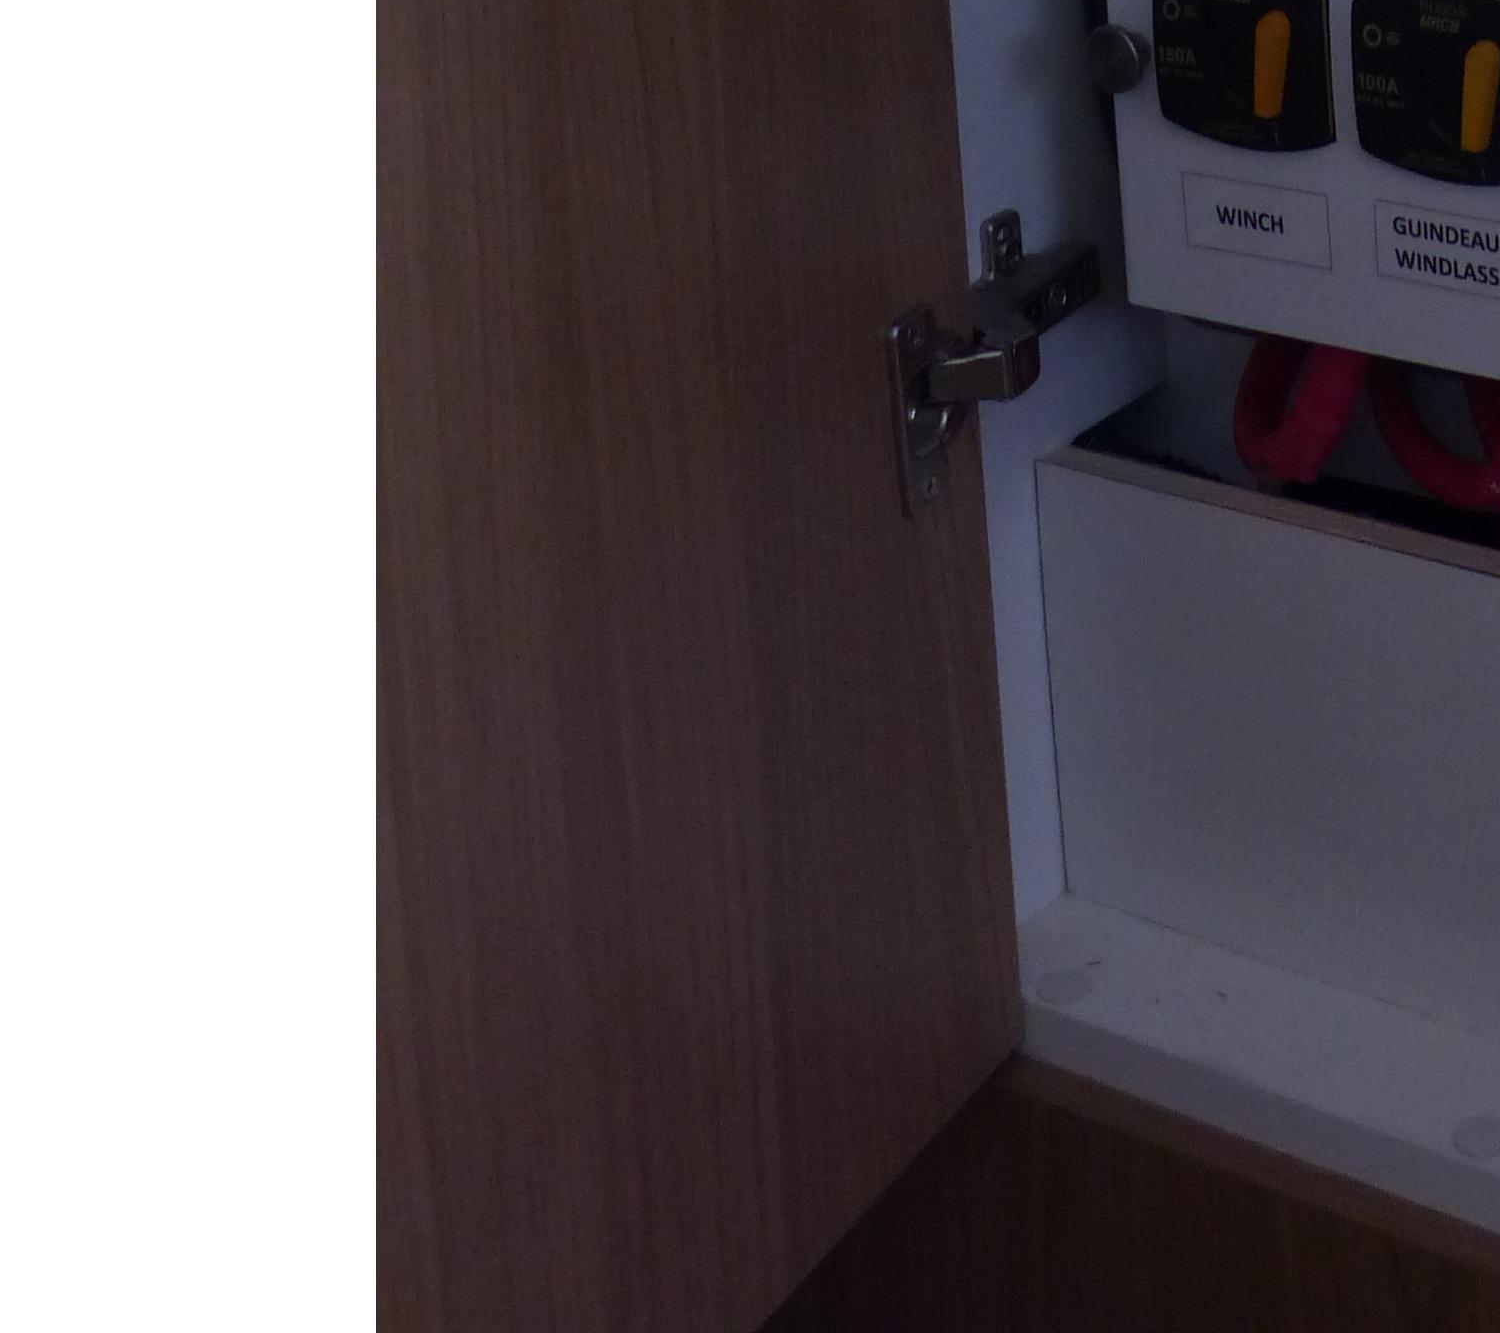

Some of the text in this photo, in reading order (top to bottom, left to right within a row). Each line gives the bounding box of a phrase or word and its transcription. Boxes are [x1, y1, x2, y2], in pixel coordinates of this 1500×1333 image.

[1357, 73, 1399, 96] 100A
[1216, 205, 1284, 234] WINCH
[1392, 216, 1500, 252] GUINDEAU
[1395, 248, 1500, 285] WINDLASS
